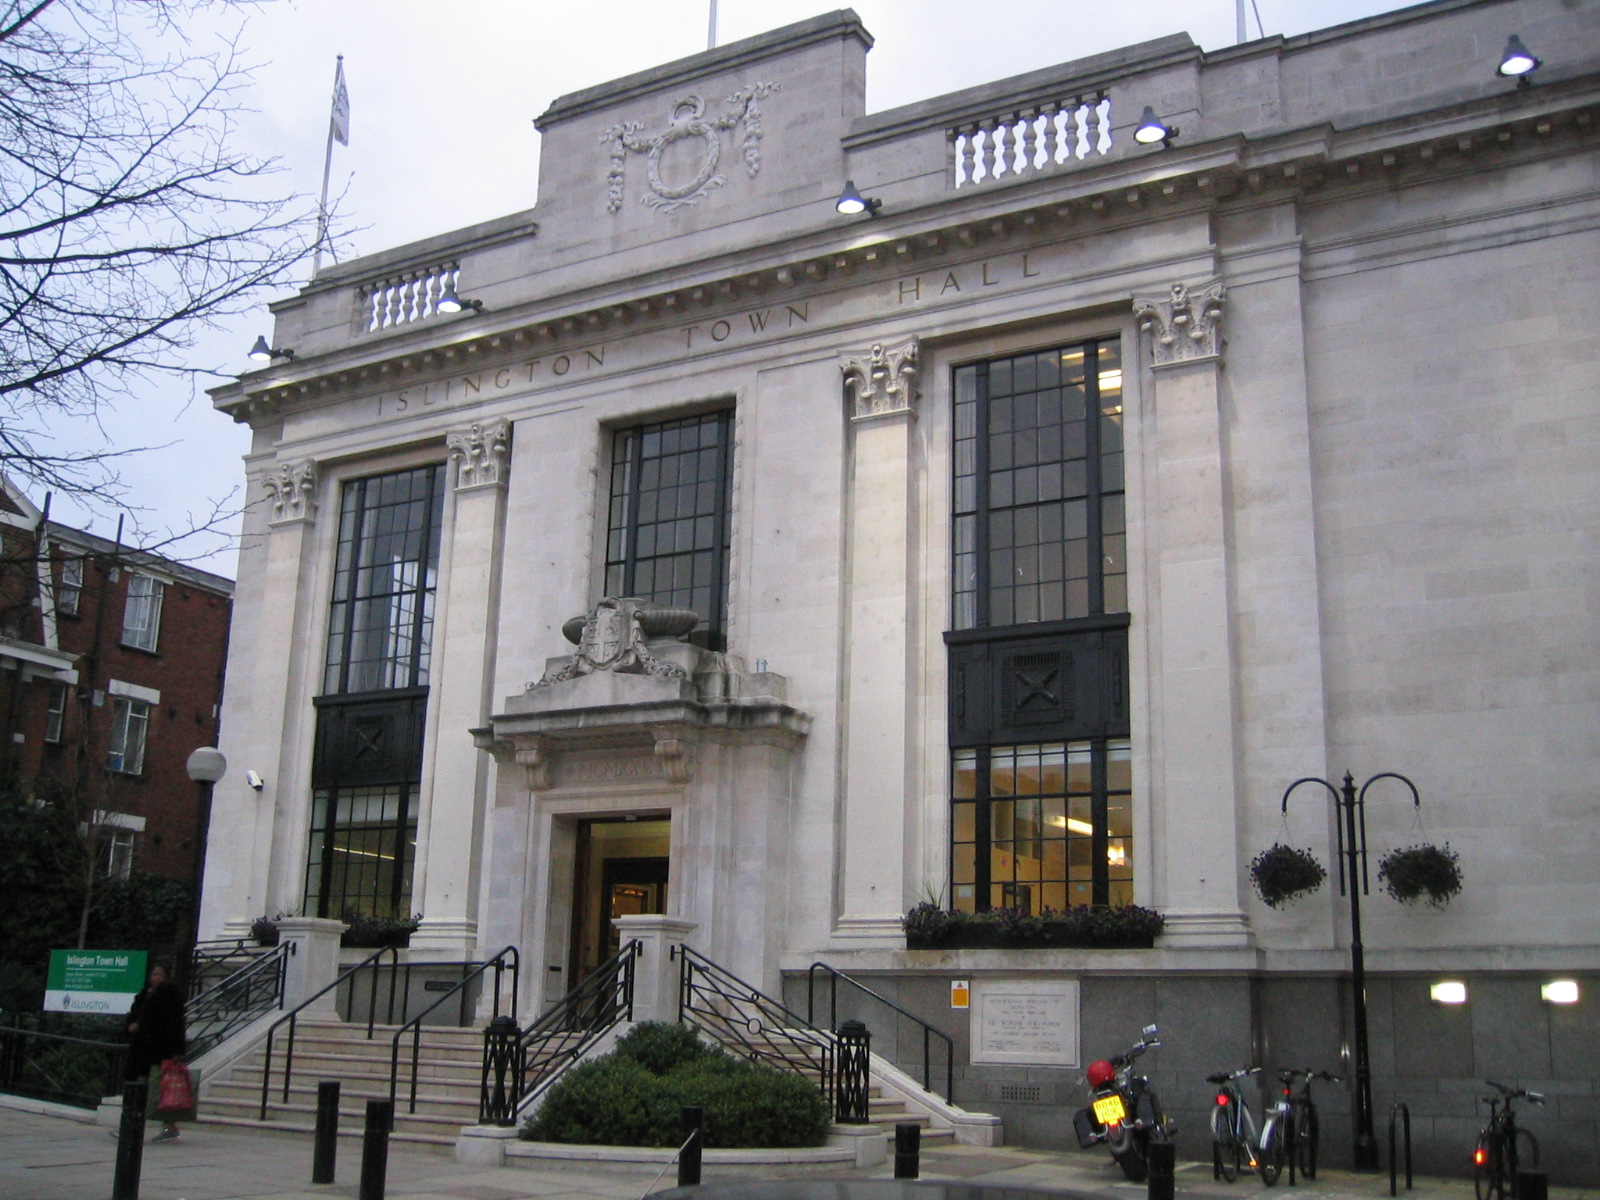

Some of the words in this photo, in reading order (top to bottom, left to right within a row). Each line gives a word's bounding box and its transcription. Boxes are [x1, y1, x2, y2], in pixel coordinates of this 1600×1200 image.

[377, 346, 605, 416] ISLINGTON
[680, 301, 809, 349] TOWN
[898, 254, 1041, 304] HALL
[66, 954, 95, 967] Islington
[96, 955, 114, 966] Town
[114, 955, 129, 966] Hall
[70, 998, 110, 1010] ISLINGTON
